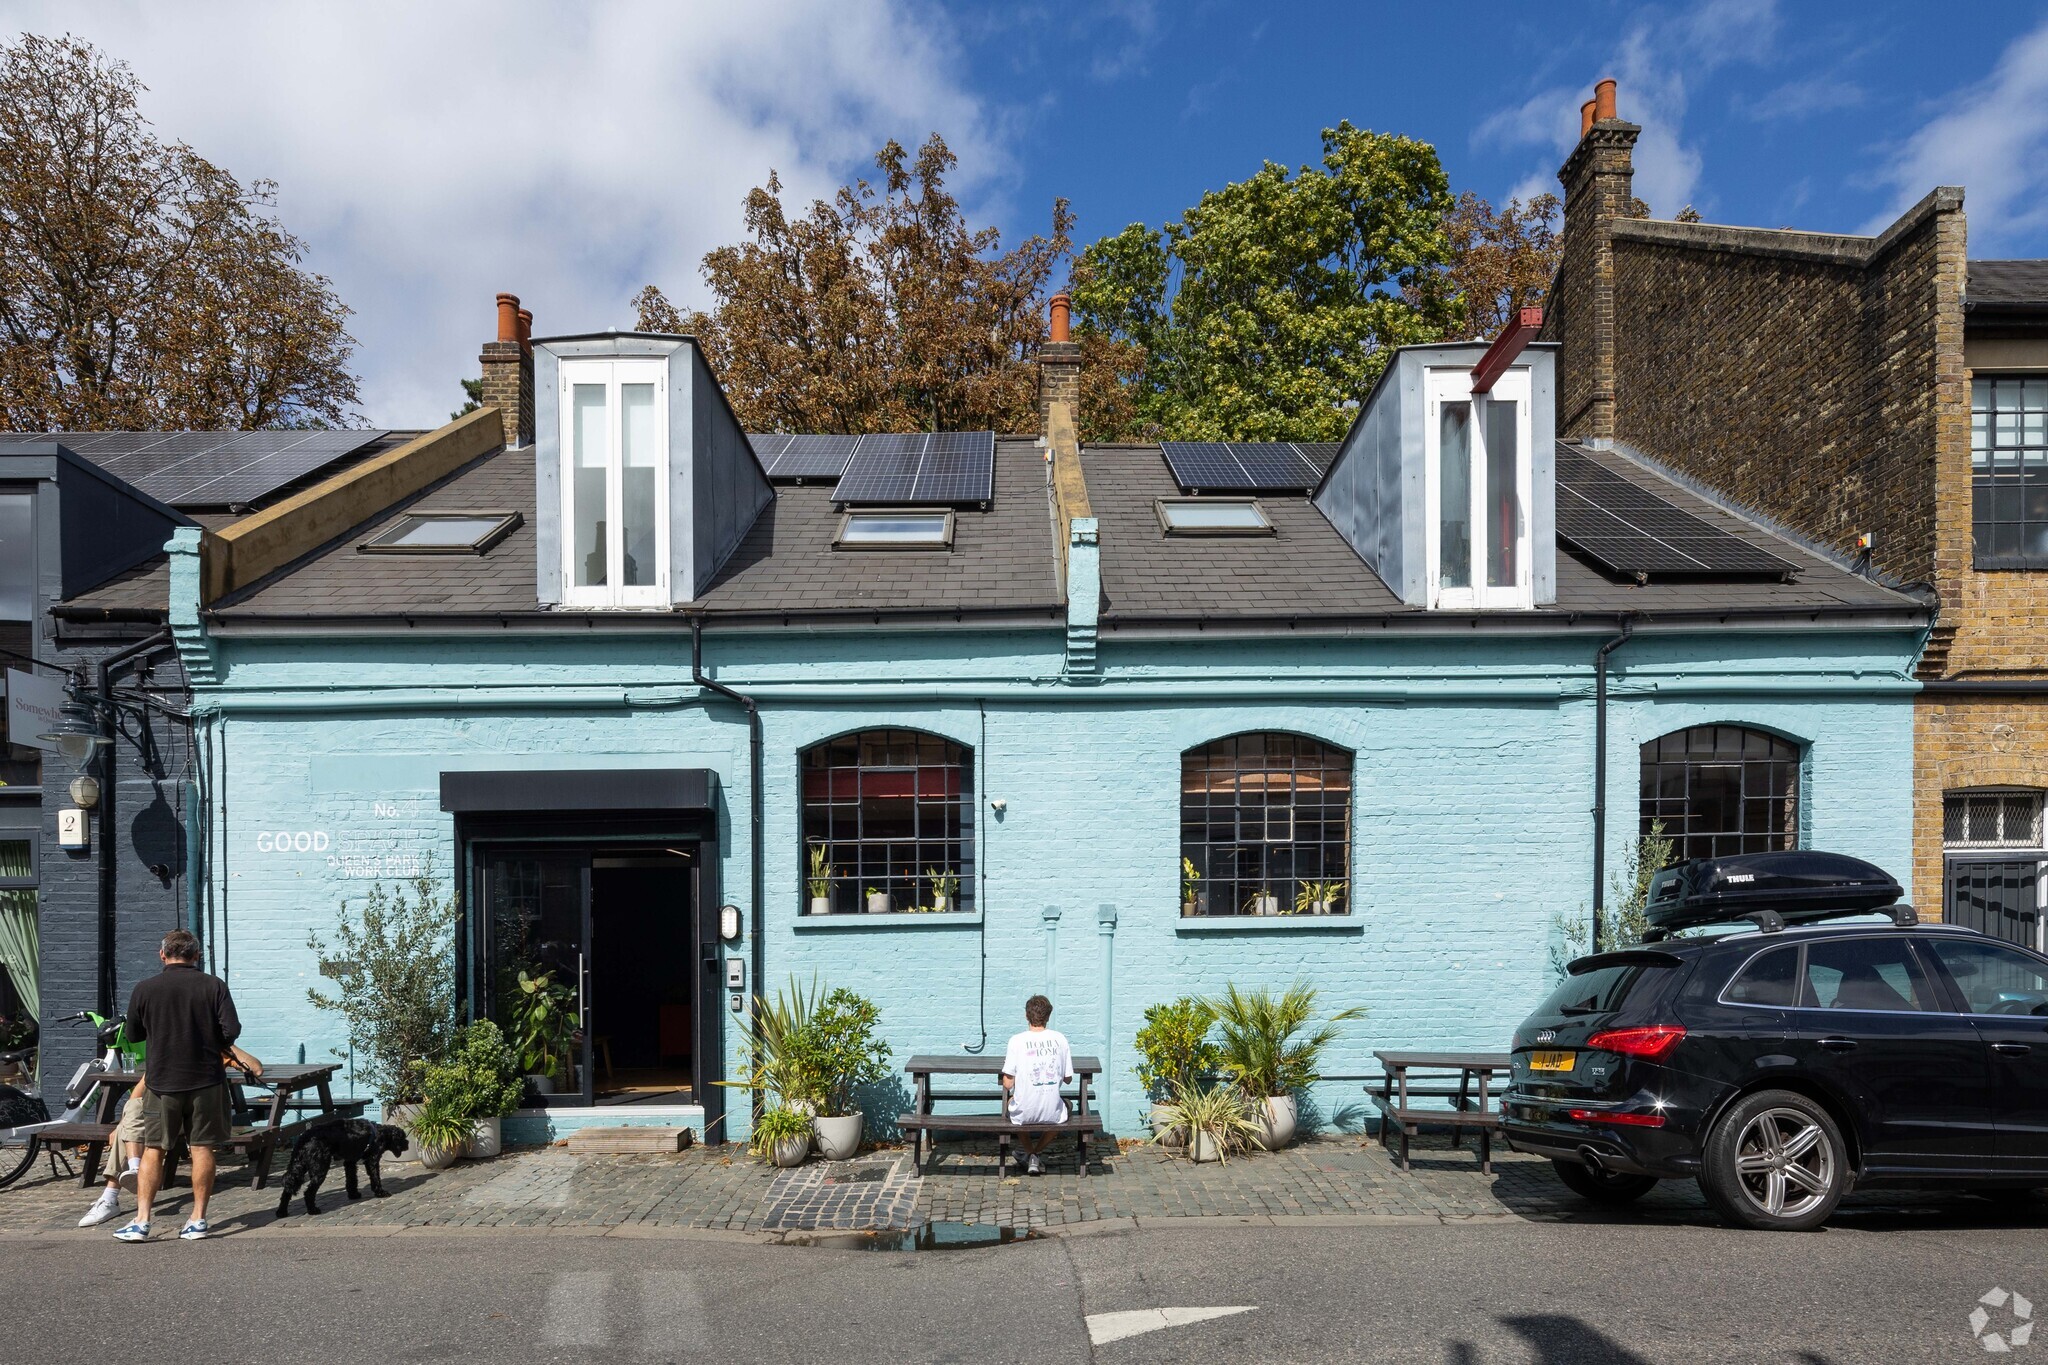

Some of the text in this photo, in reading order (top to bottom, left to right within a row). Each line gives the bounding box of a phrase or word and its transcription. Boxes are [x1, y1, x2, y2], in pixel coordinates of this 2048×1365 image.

[16, 697, 63, 719] Somewhe
[64, 815, 75, 832] 2
[257, 830, 420, 852] GOOD SPACE
[385, 855, 420, 866] PARK
[344, 866, 382, 877] WORK
[1727, 874, 1755, 883] THULE
